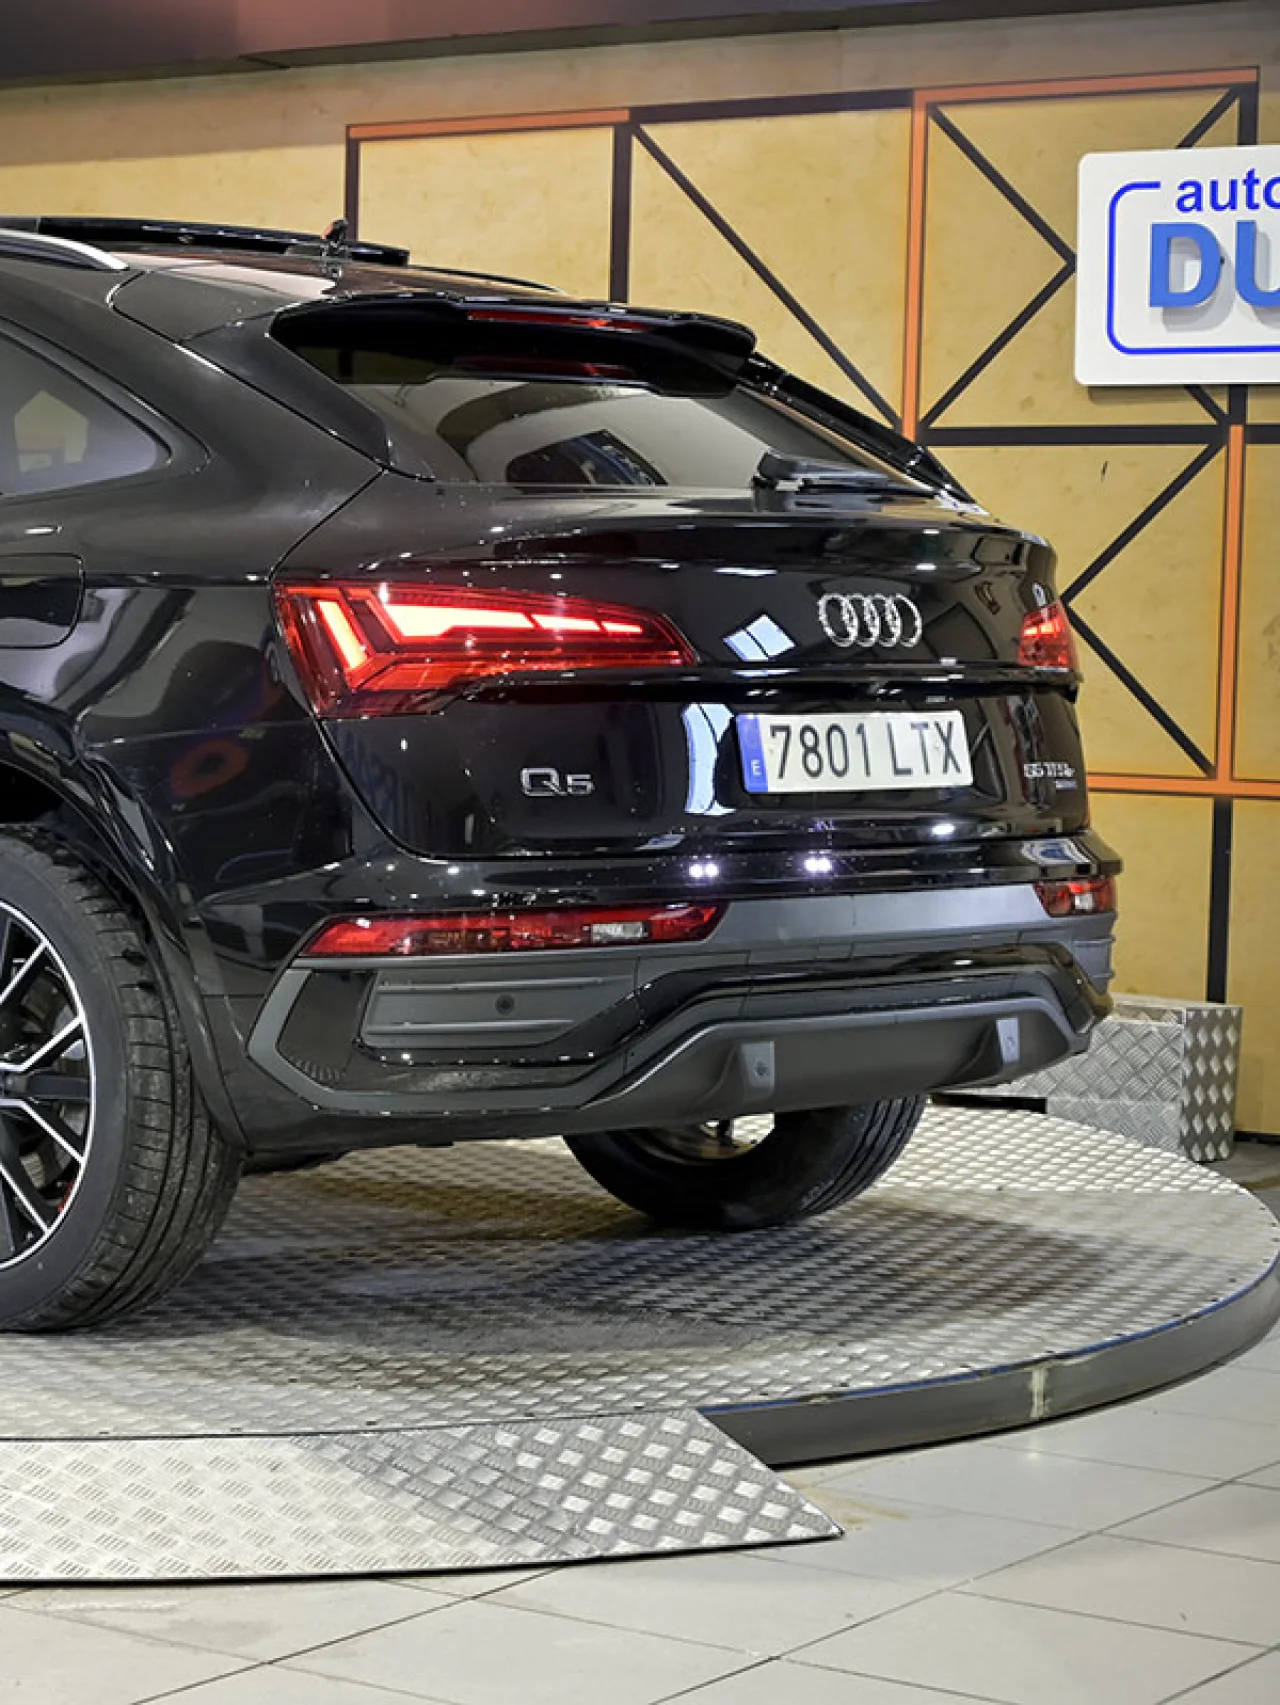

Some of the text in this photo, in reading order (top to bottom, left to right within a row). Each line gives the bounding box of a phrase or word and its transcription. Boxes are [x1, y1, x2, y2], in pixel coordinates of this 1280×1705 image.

[770, 720, 962, 780] 7801 LTX
[522, 767, 595, 797] Q5
[751, 759, 762, 776] E
